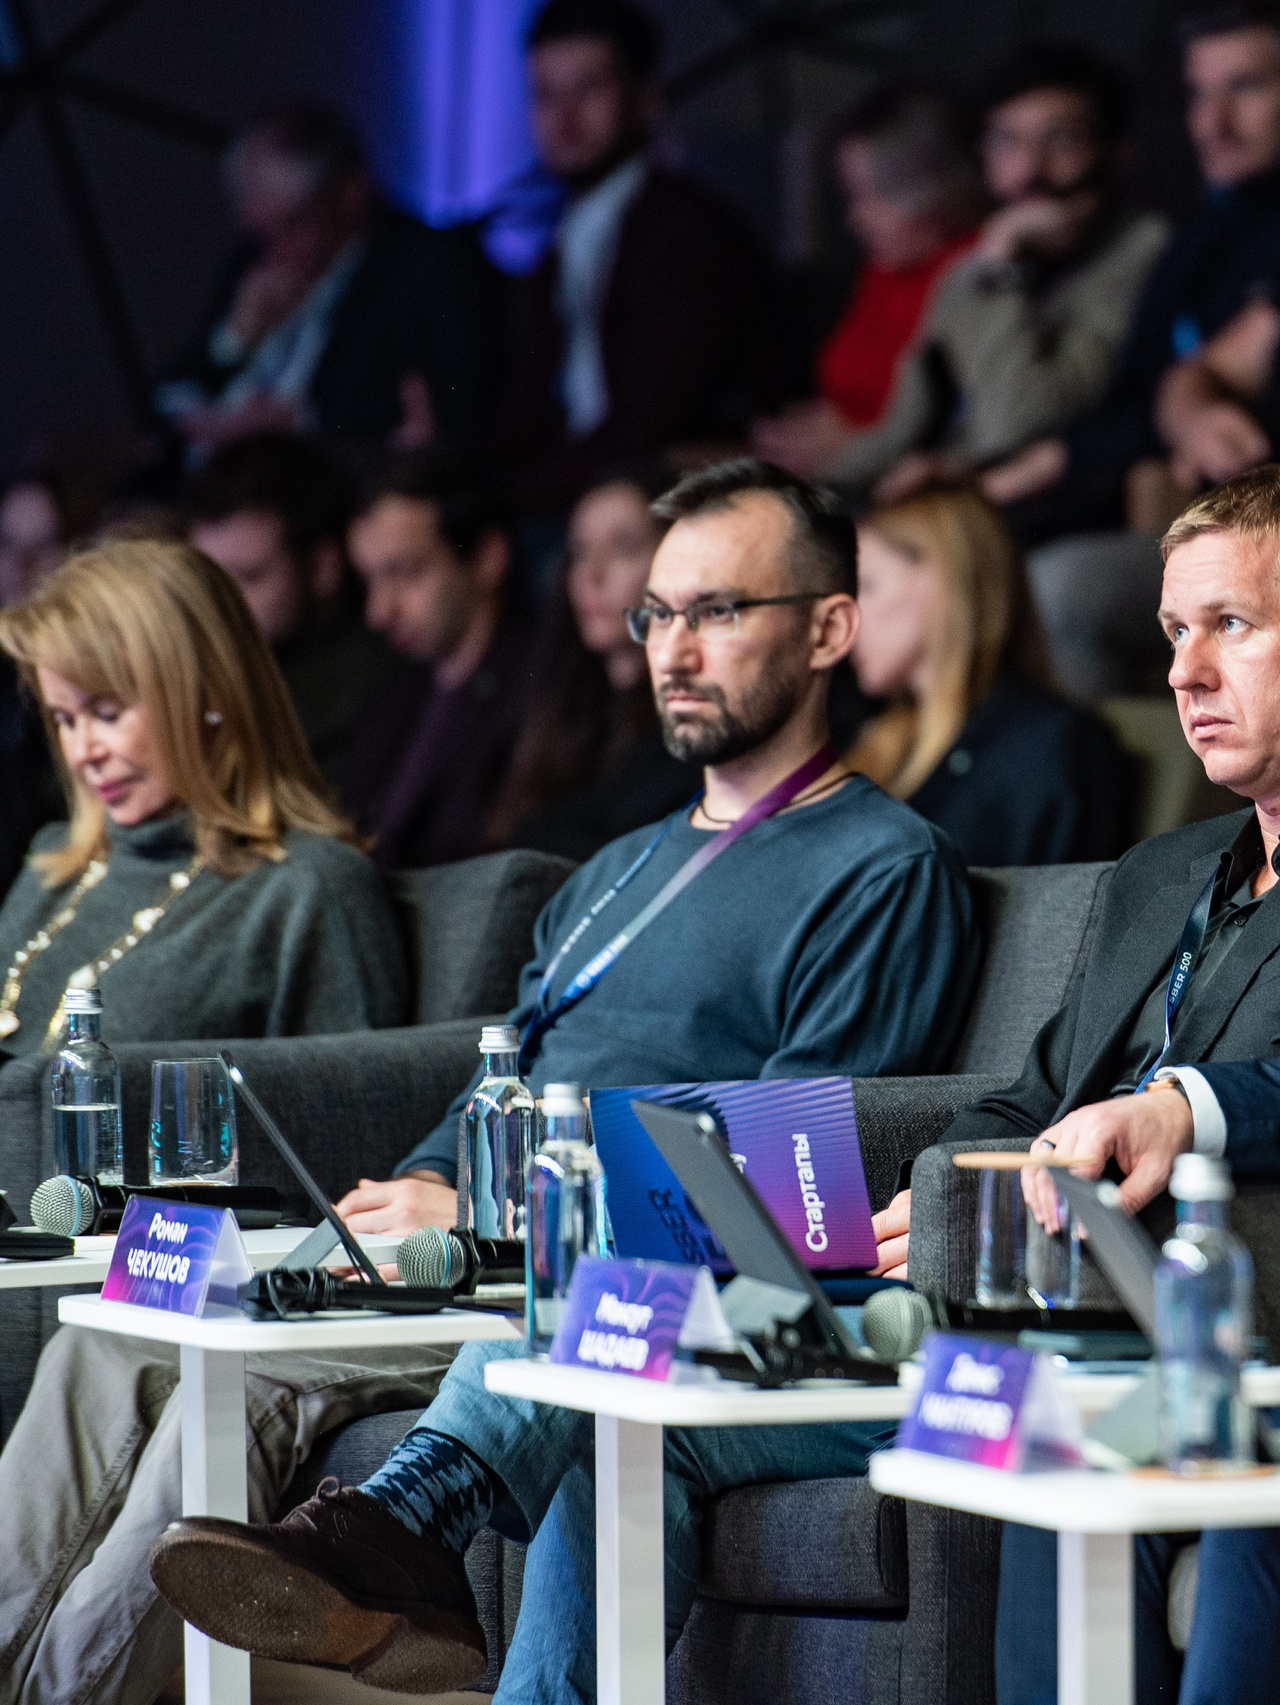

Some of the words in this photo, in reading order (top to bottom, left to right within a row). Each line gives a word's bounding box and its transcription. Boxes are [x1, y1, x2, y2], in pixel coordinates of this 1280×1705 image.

[1180, 952, 1191, 971] 500
[791, 1133, 829, 1253] Стартапы
[148, 1211, 189, 1245] Роман
[126, 1247, 191, 1285] ЧЕКУШОВ
